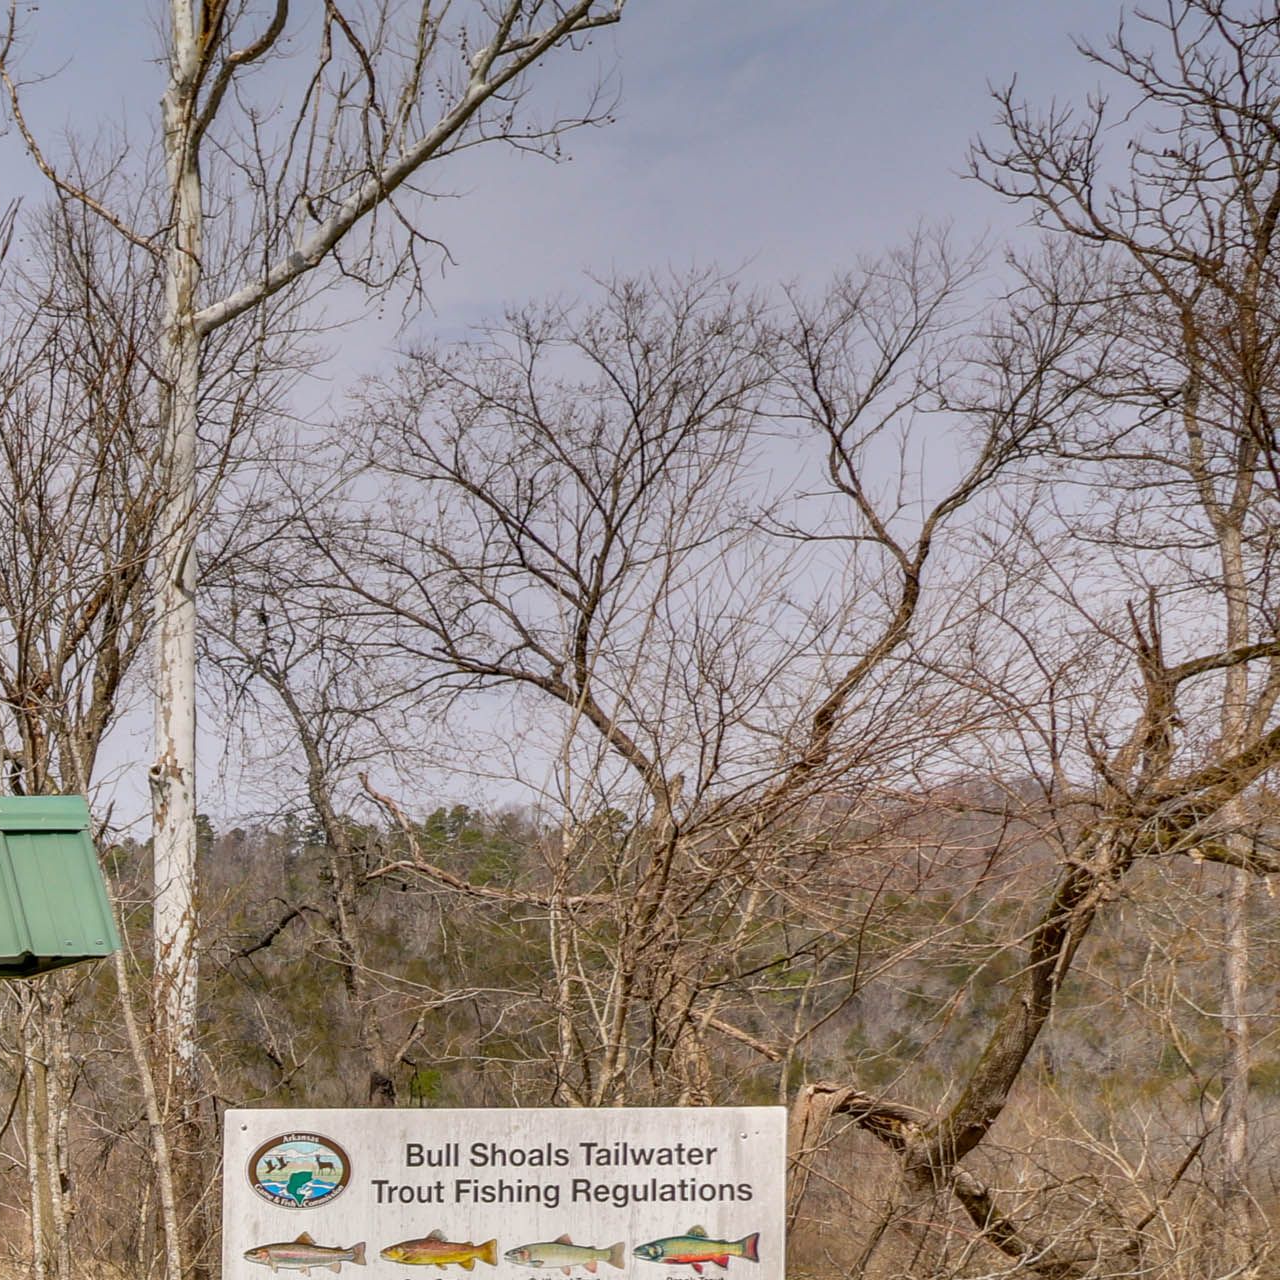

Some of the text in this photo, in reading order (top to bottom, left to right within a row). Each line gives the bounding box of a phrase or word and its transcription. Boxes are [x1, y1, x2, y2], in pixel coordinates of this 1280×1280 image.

[405, 1141, 718, 1168] Bull Shoals Tailwater
[371, 1179, 445, 1204] Trout
[454, 1178, 560, 1209] Fishing
[571, 1176, 753, 1209] Regulations
